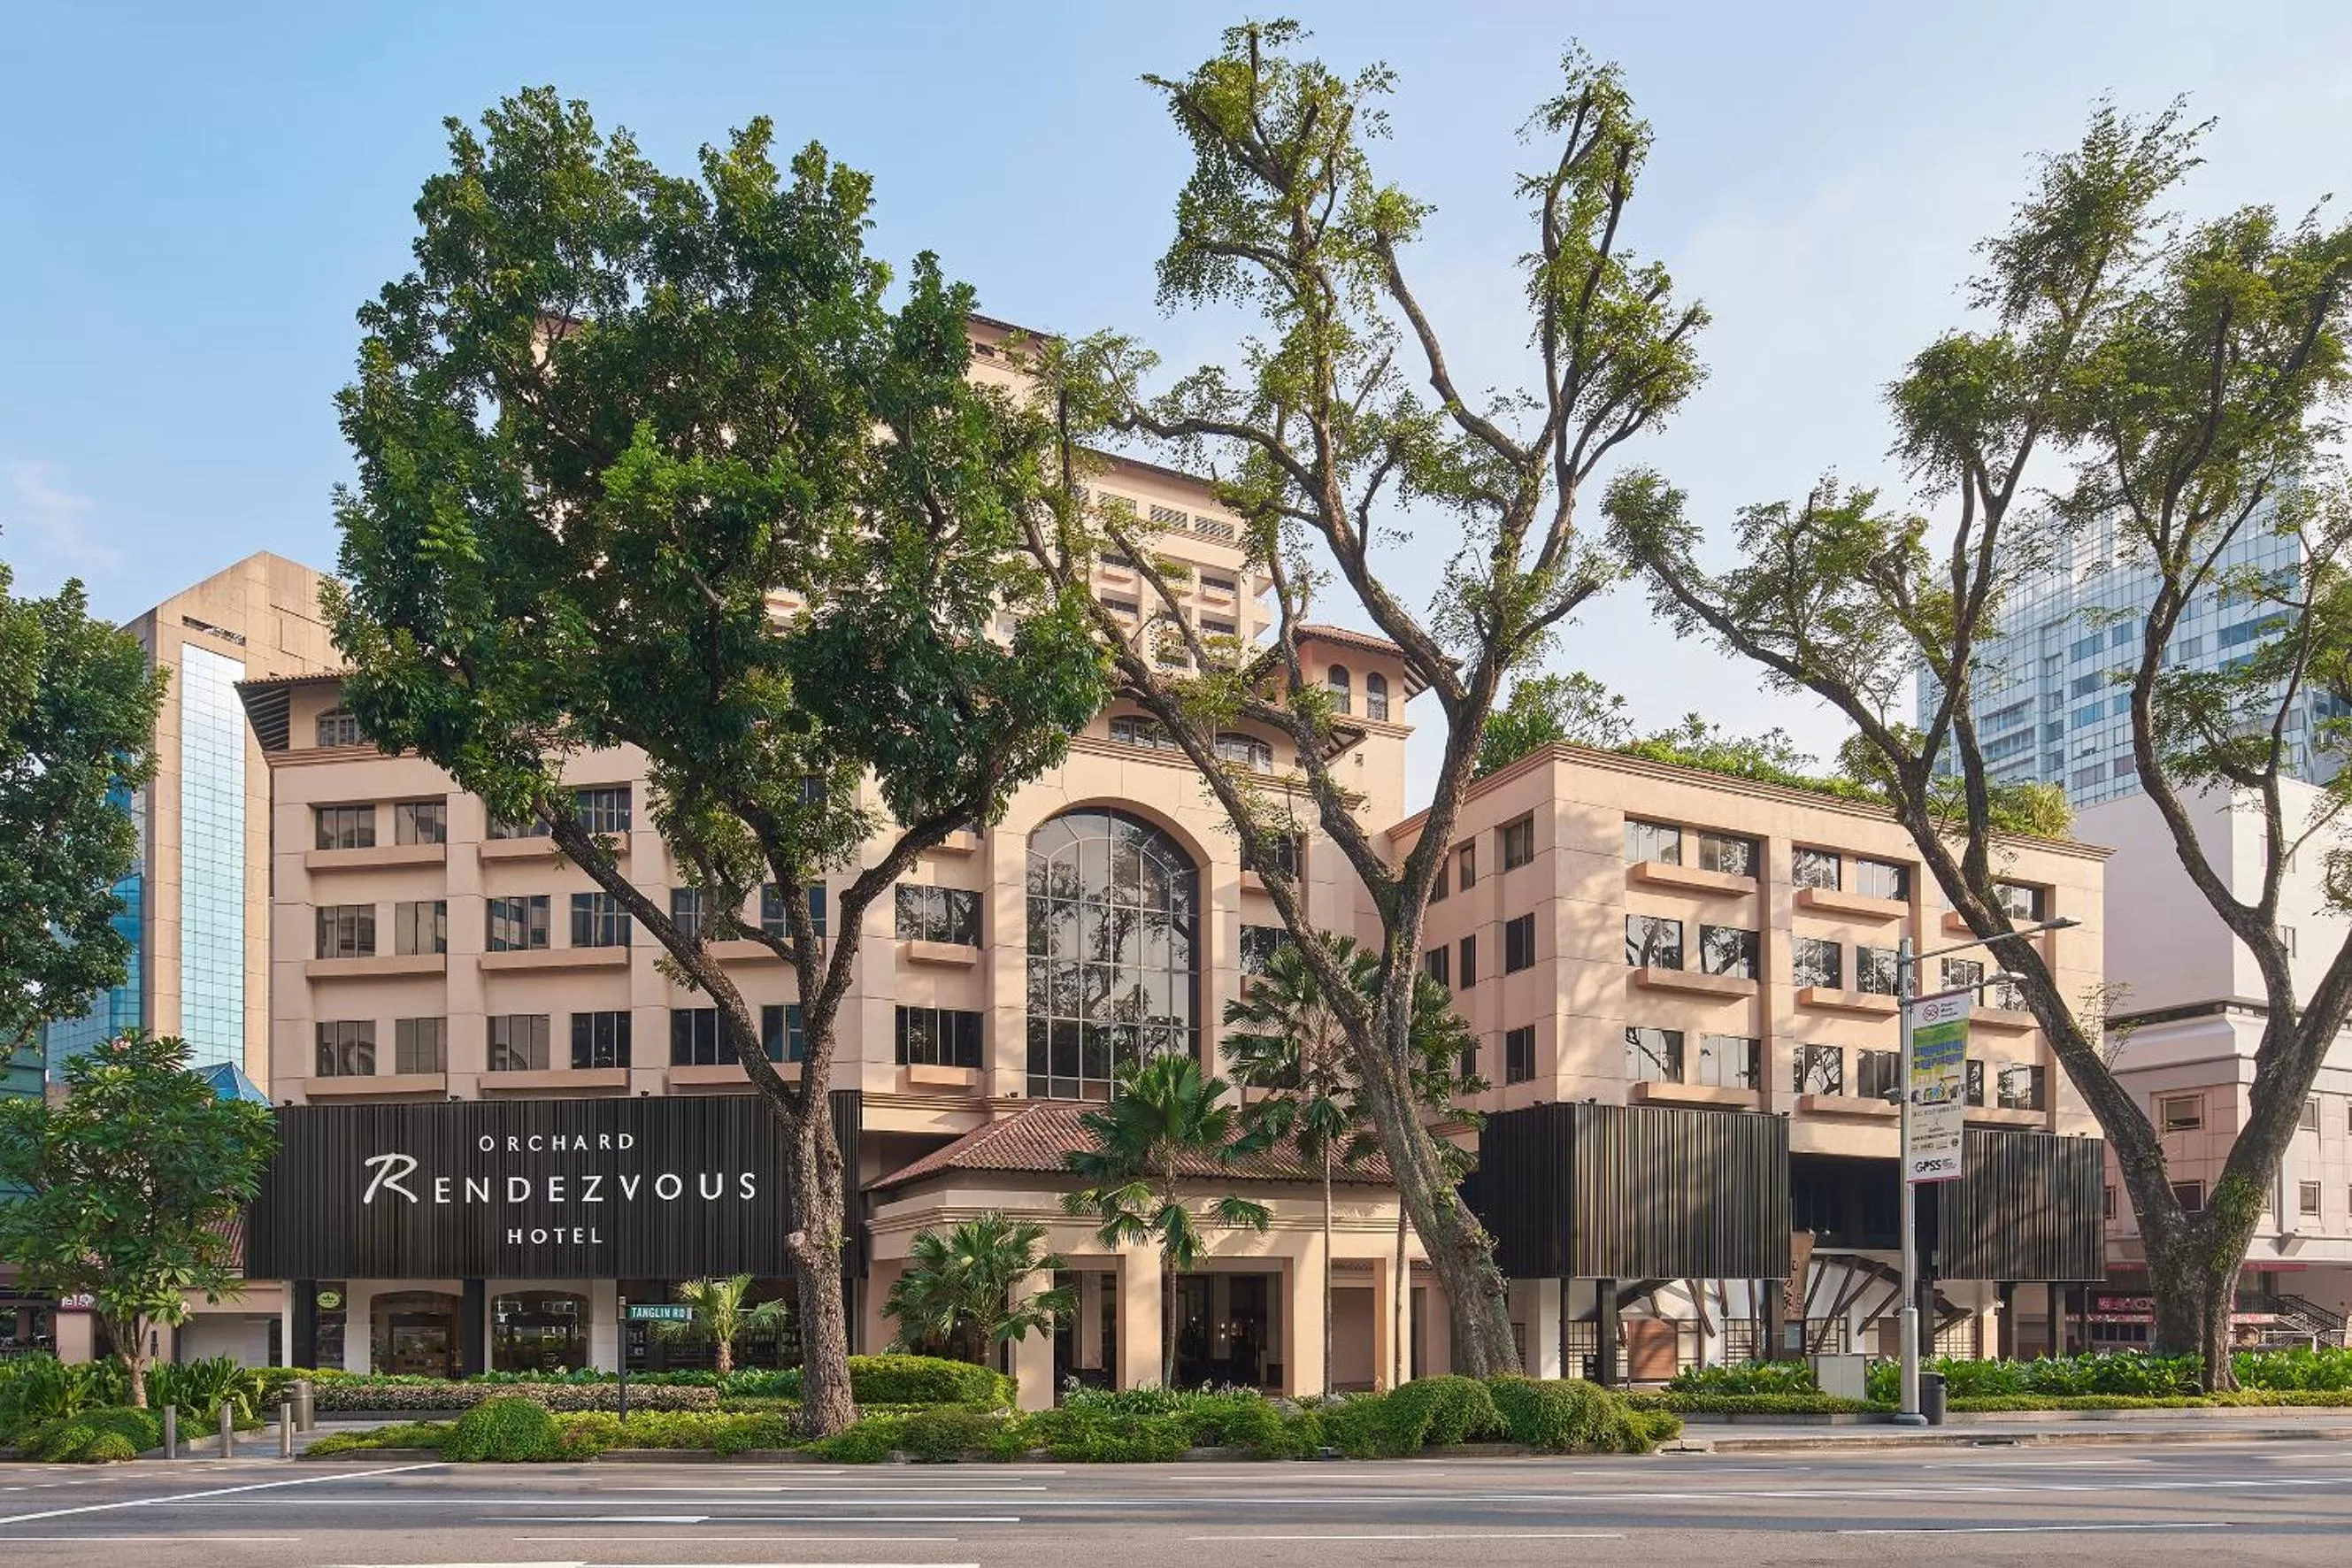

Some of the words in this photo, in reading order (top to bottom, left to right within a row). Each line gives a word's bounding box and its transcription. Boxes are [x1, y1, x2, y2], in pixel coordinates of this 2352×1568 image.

[479, 1133, 634, 1152] ORCHARD
[1915, 1159, 1941, 1173] GPSS
[363, 1152, 757, 1204] RENDEZVOUS
[507, 1227, 603, 1245] HOTEL
[631, 1307, 671, 1318] TANGLIN
[673, 1307, 686, 1318] RD
